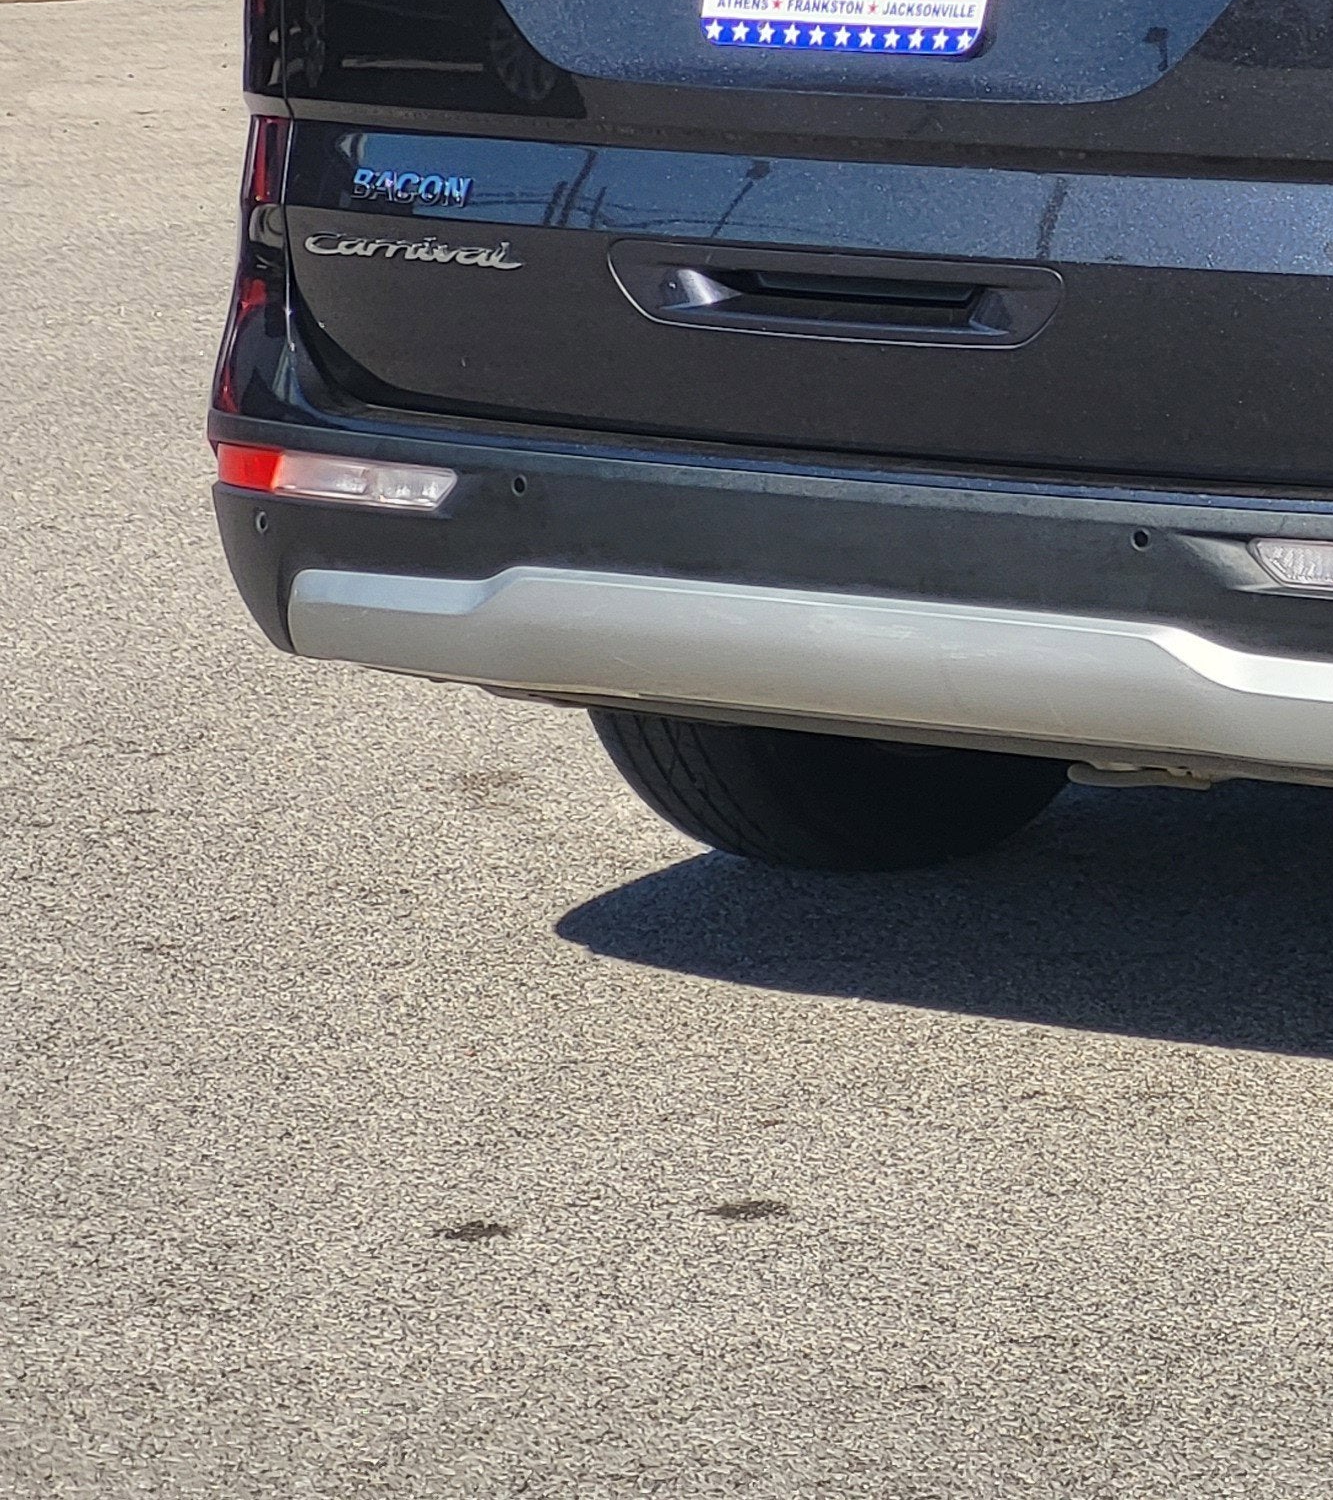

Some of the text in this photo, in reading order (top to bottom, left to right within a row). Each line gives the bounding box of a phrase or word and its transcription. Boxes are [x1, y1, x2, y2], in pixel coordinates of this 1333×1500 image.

[882, 0, 977, 19] JACKSONVILLE
[351, 167, 473, 208] BACON
[304, 230, 524, 271] Carnival
